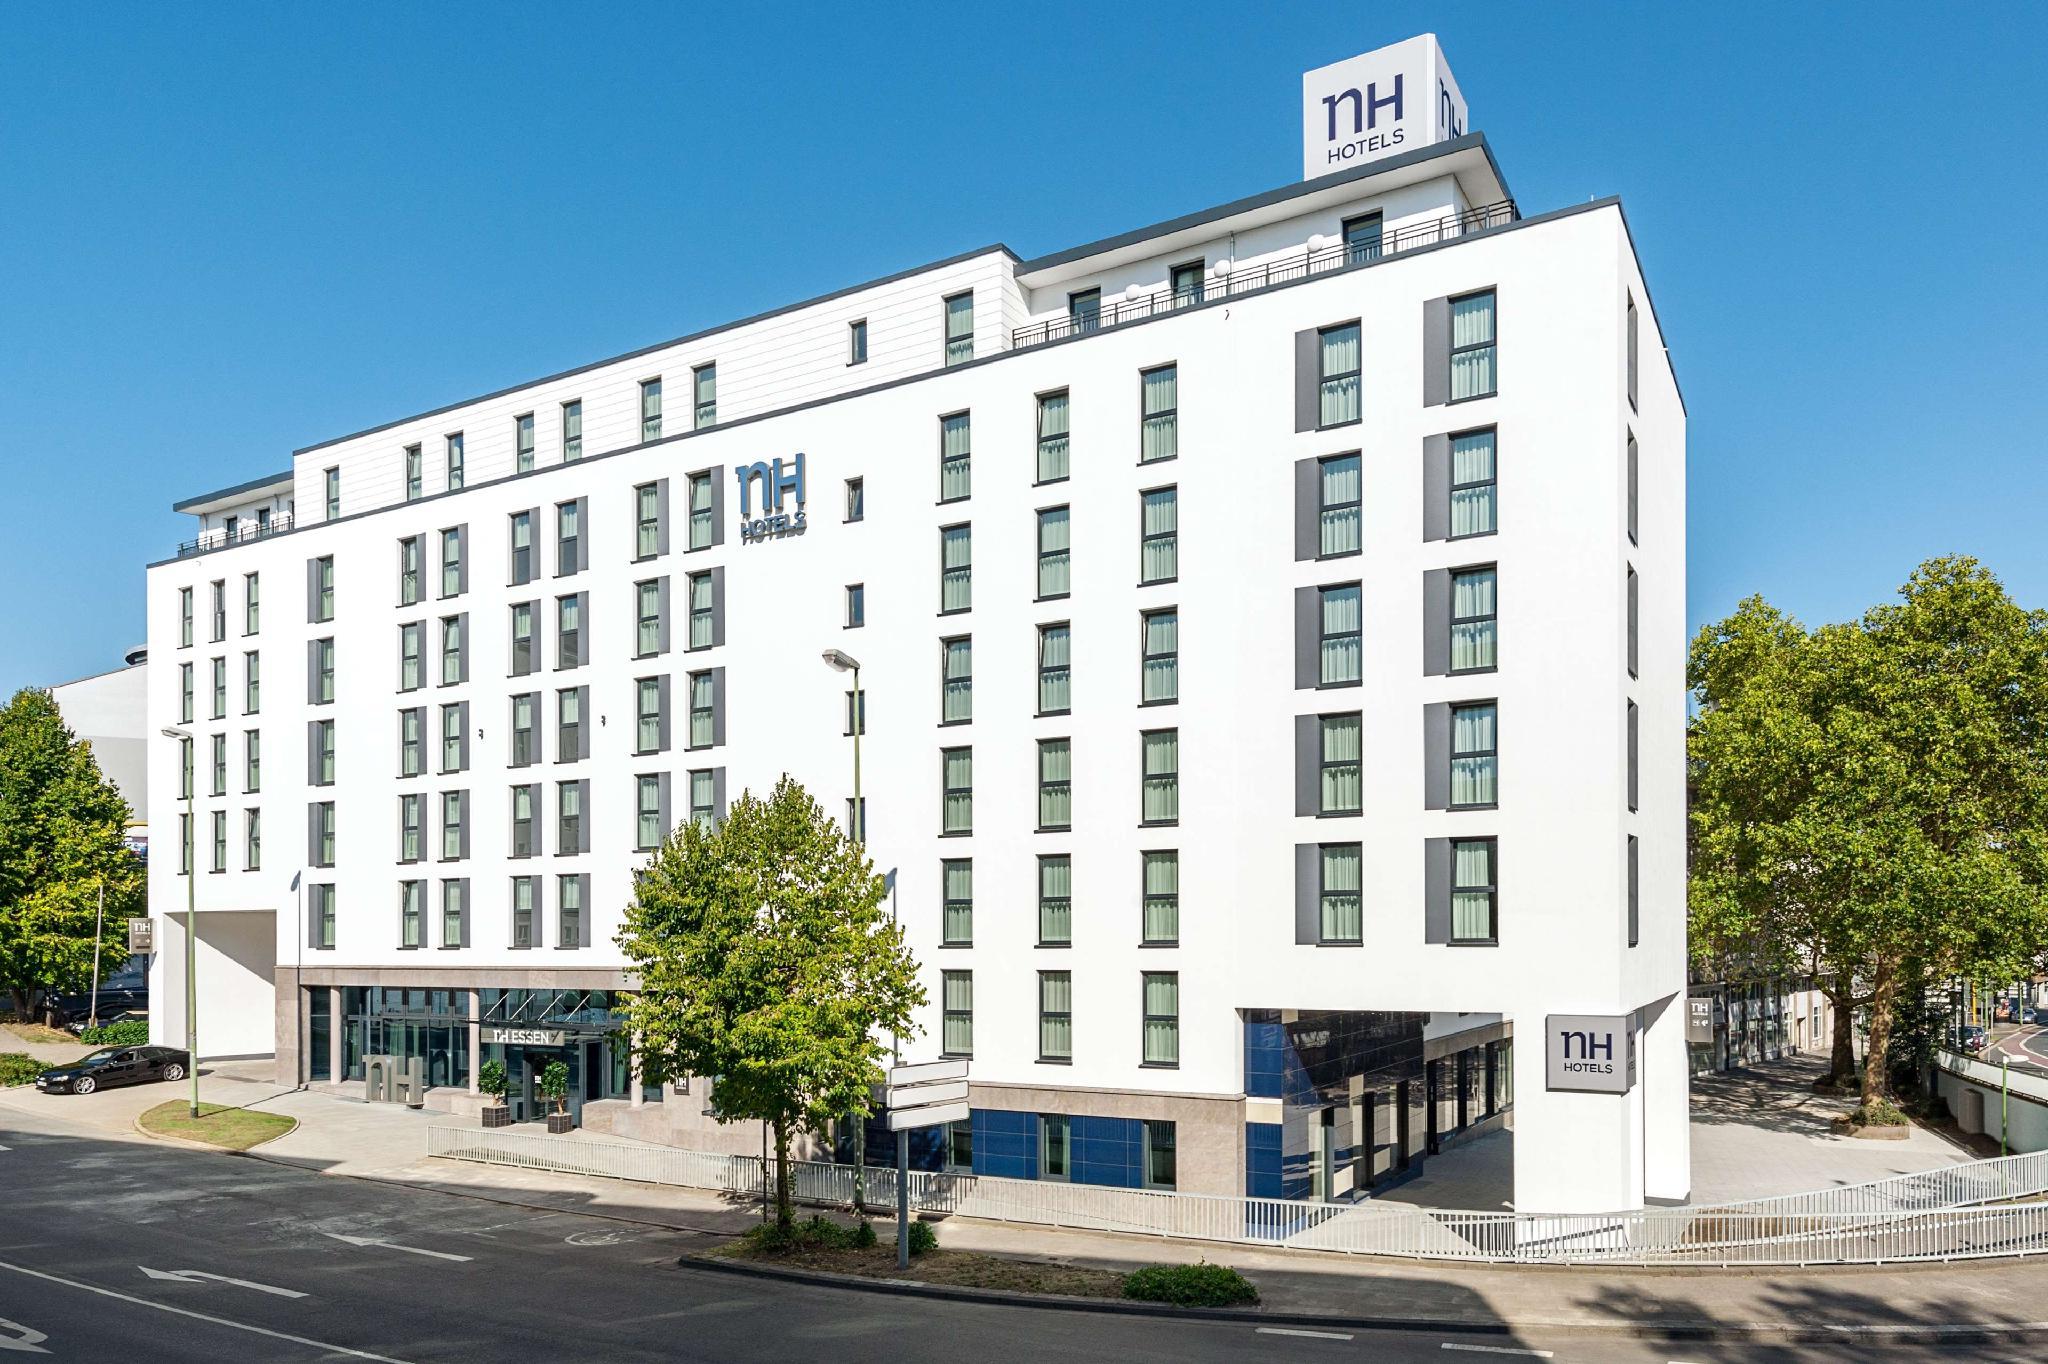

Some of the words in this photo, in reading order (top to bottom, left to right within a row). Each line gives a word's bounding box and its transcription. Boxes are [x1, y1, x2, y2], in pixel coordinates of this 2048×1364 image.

[1328, 128, 1404, 164] HOTELS
[741, 511, 807, 543] HOTELS
[511, 1030, 549, 1044] ESSEN
[1564, 1062, 1613, 1074] HOTELS
